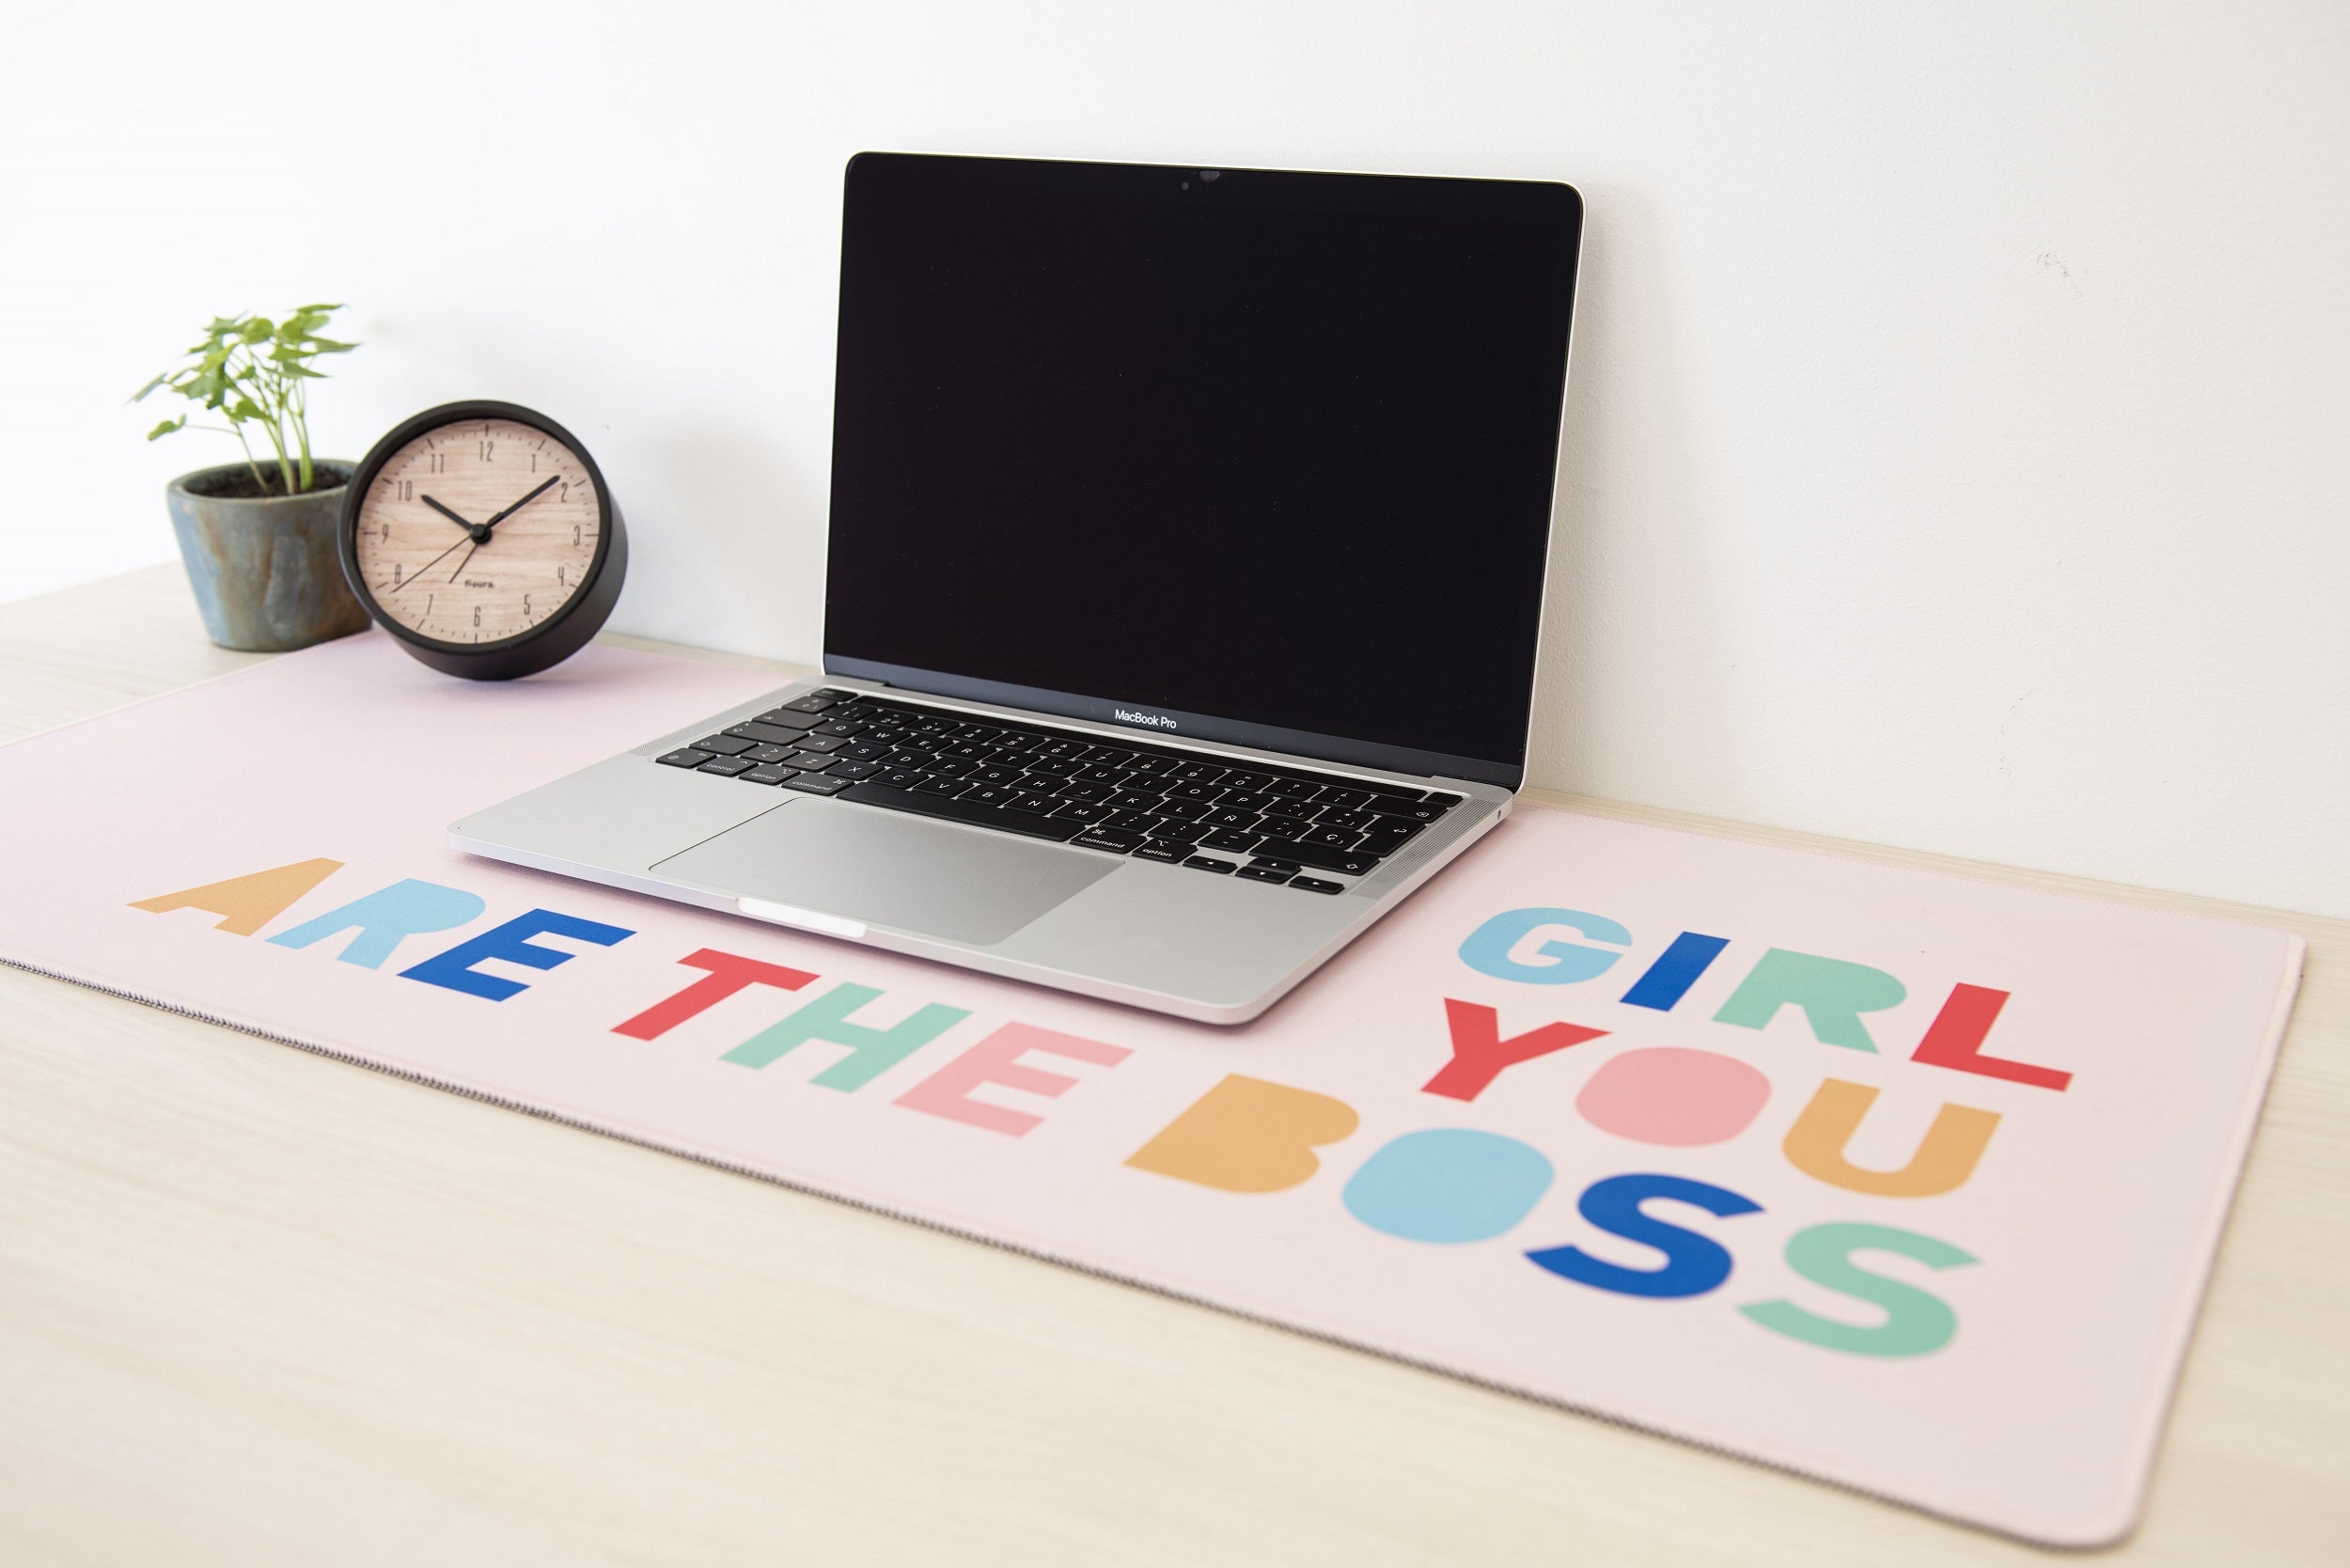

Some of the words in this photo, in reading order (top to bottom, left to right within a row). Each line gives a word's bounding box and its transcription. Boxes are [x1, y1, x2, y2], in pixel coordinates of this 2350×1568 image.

[479, 441, 494, 462] 12
[431, 454, 445, 474] 11
[531, 454, 536, 474] 1
[398, 480, 413, 501] 10
[561, 482, 569, 504] 2
[381, 524, 389, 544] 9
[572, 525, 581, 546] 3
[394, 564, 402, 585] 8
[557, 566, 565, 587] 4
[428, 594, 434, 615] 7
[524, 594, 531, 616] 5
[474, 605, 481, 627] 6
[1115, 709, 1159, 727] MacBook
[1160, 716, 1177, 729] Pro
[706, 763, 736, 772] control
[751, 772, 776, 780] option
[791, 780, 832, 792] command
[1080, 837, 1125, 849] command
[1142, 848, 1172, 857] option
[1458, 907, 2074, 1092] GIRL
[125, 856, 638, 1002] ARE
[609, 948, 1136, 1139] THE
[1121, 1073, 1983, 1360] BOSS
[1420, 996, 2003, 1199] YOU
